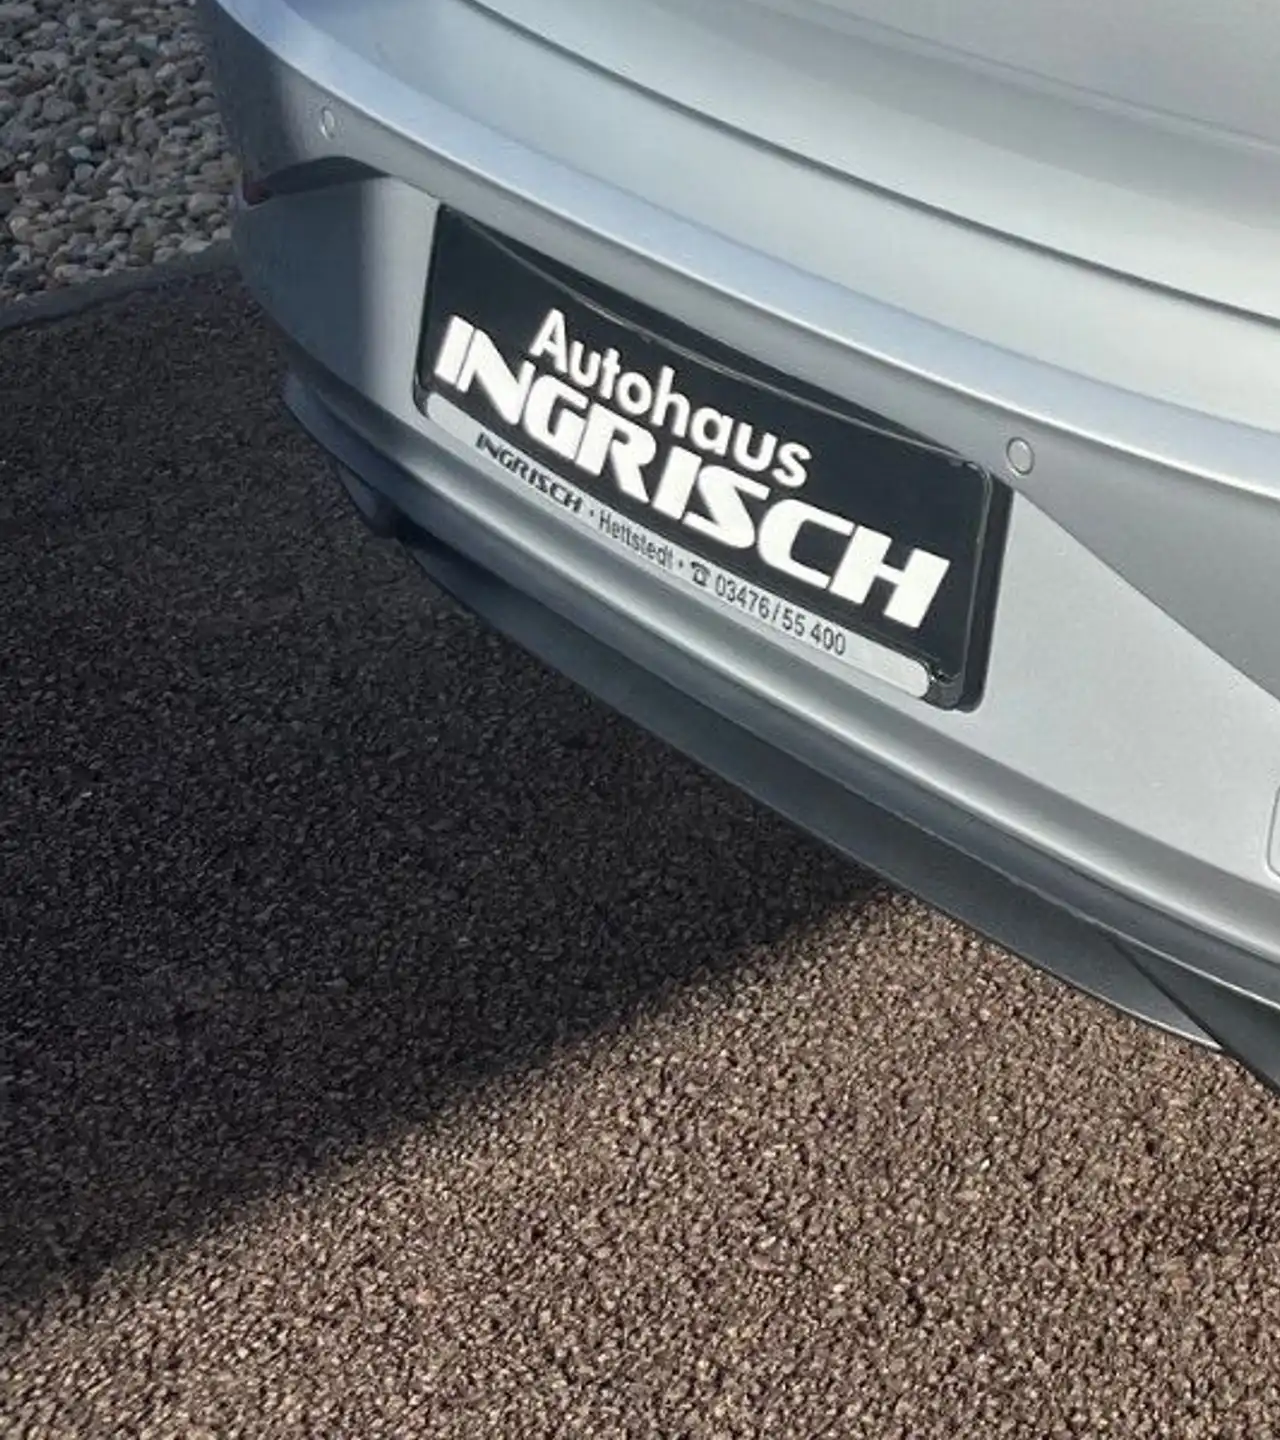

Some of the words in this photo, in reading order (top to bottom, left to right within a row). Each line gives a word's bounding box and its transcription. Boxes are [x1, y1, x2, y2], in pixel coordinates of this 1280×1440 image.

[434, 314, 952, 629] INGRISCH
[528, 307, 813, 489] Autohaus
[475, 431, 584, 514] INGRISCH
[598, 509, 674, 572] Hettstedt
[809, 622, 847, 656] 400
